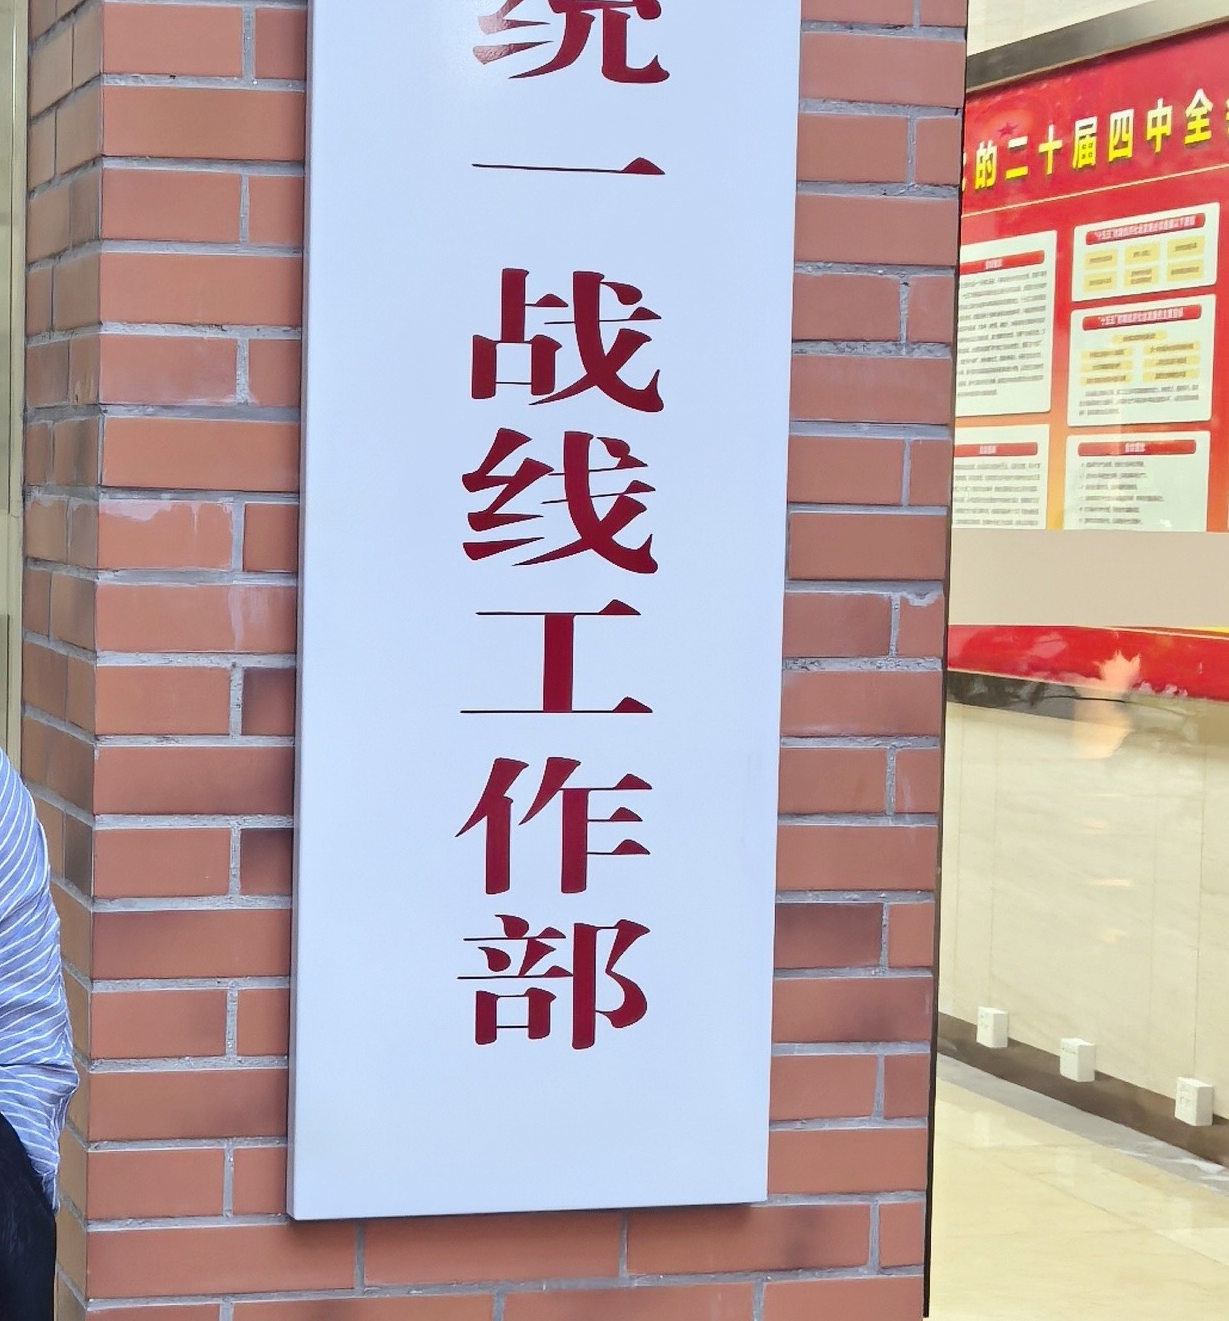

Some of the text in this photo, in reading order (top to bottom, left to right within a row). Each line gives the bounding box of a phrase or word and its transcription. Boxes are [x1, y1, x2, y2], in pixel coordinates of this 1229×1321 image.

[962, 88, 1229, 192] 的二十届四中全
